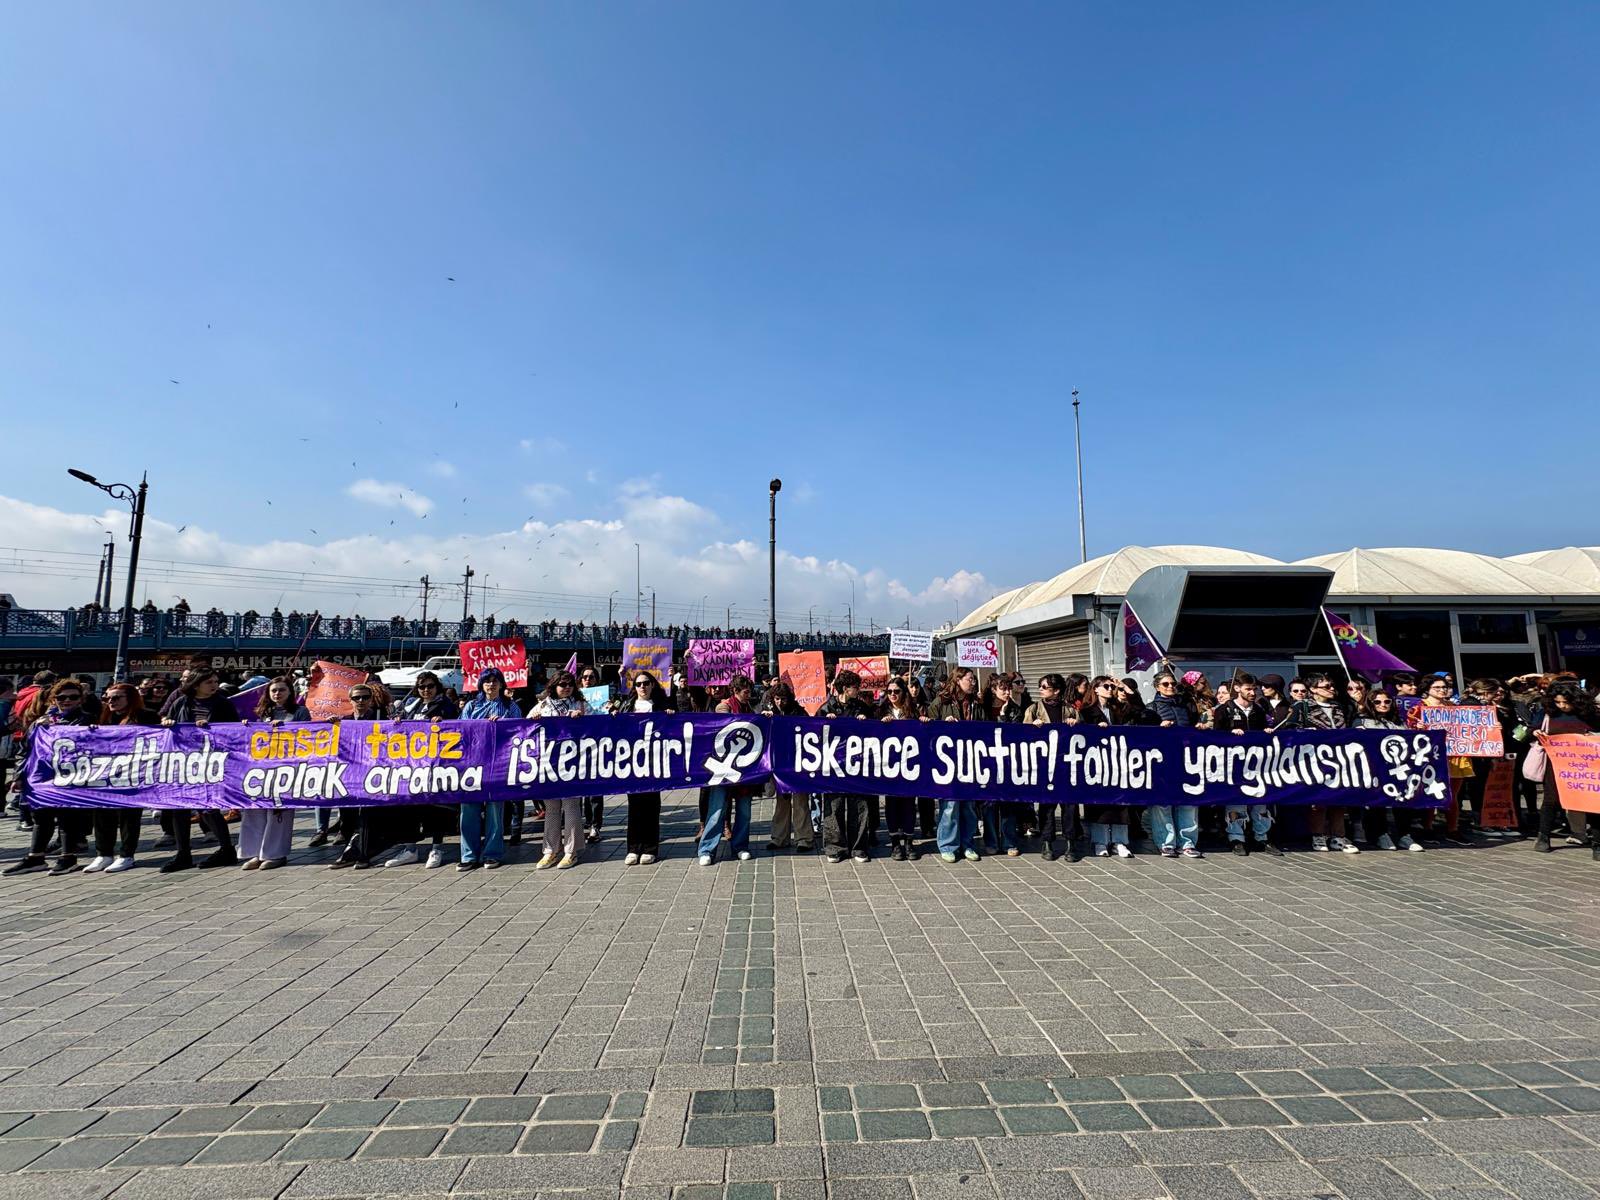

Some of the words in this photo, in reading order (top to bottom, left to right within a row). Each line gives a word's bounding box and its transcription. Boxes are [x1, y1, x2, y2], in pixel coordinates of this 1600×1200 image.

[211, 656, 267, 669] BALIK
[333, 654, 388, 667] SALATA
[469, 644, 518, 661] ÇIPLAK
[473, 657, 514, 670] ARAMA
[702, 654, 732, 666] KADIN
[467, 668, 528, 687] İŞEDİR
[249, 722, 341, 760] cinsel
[365, 723, 463, 760] taciz
[507, 721, 694, 789] işkencedir!
[52, 734, 229, 788] Gözaltında
[794, 724, 921, 781] işkence
[1063, 734, 1163, 790] failler
[1182, 735, 1379, 798] yargılansın.
[242, 761, 349, 807] çıplak
[364, 765, 483, 795] arama
